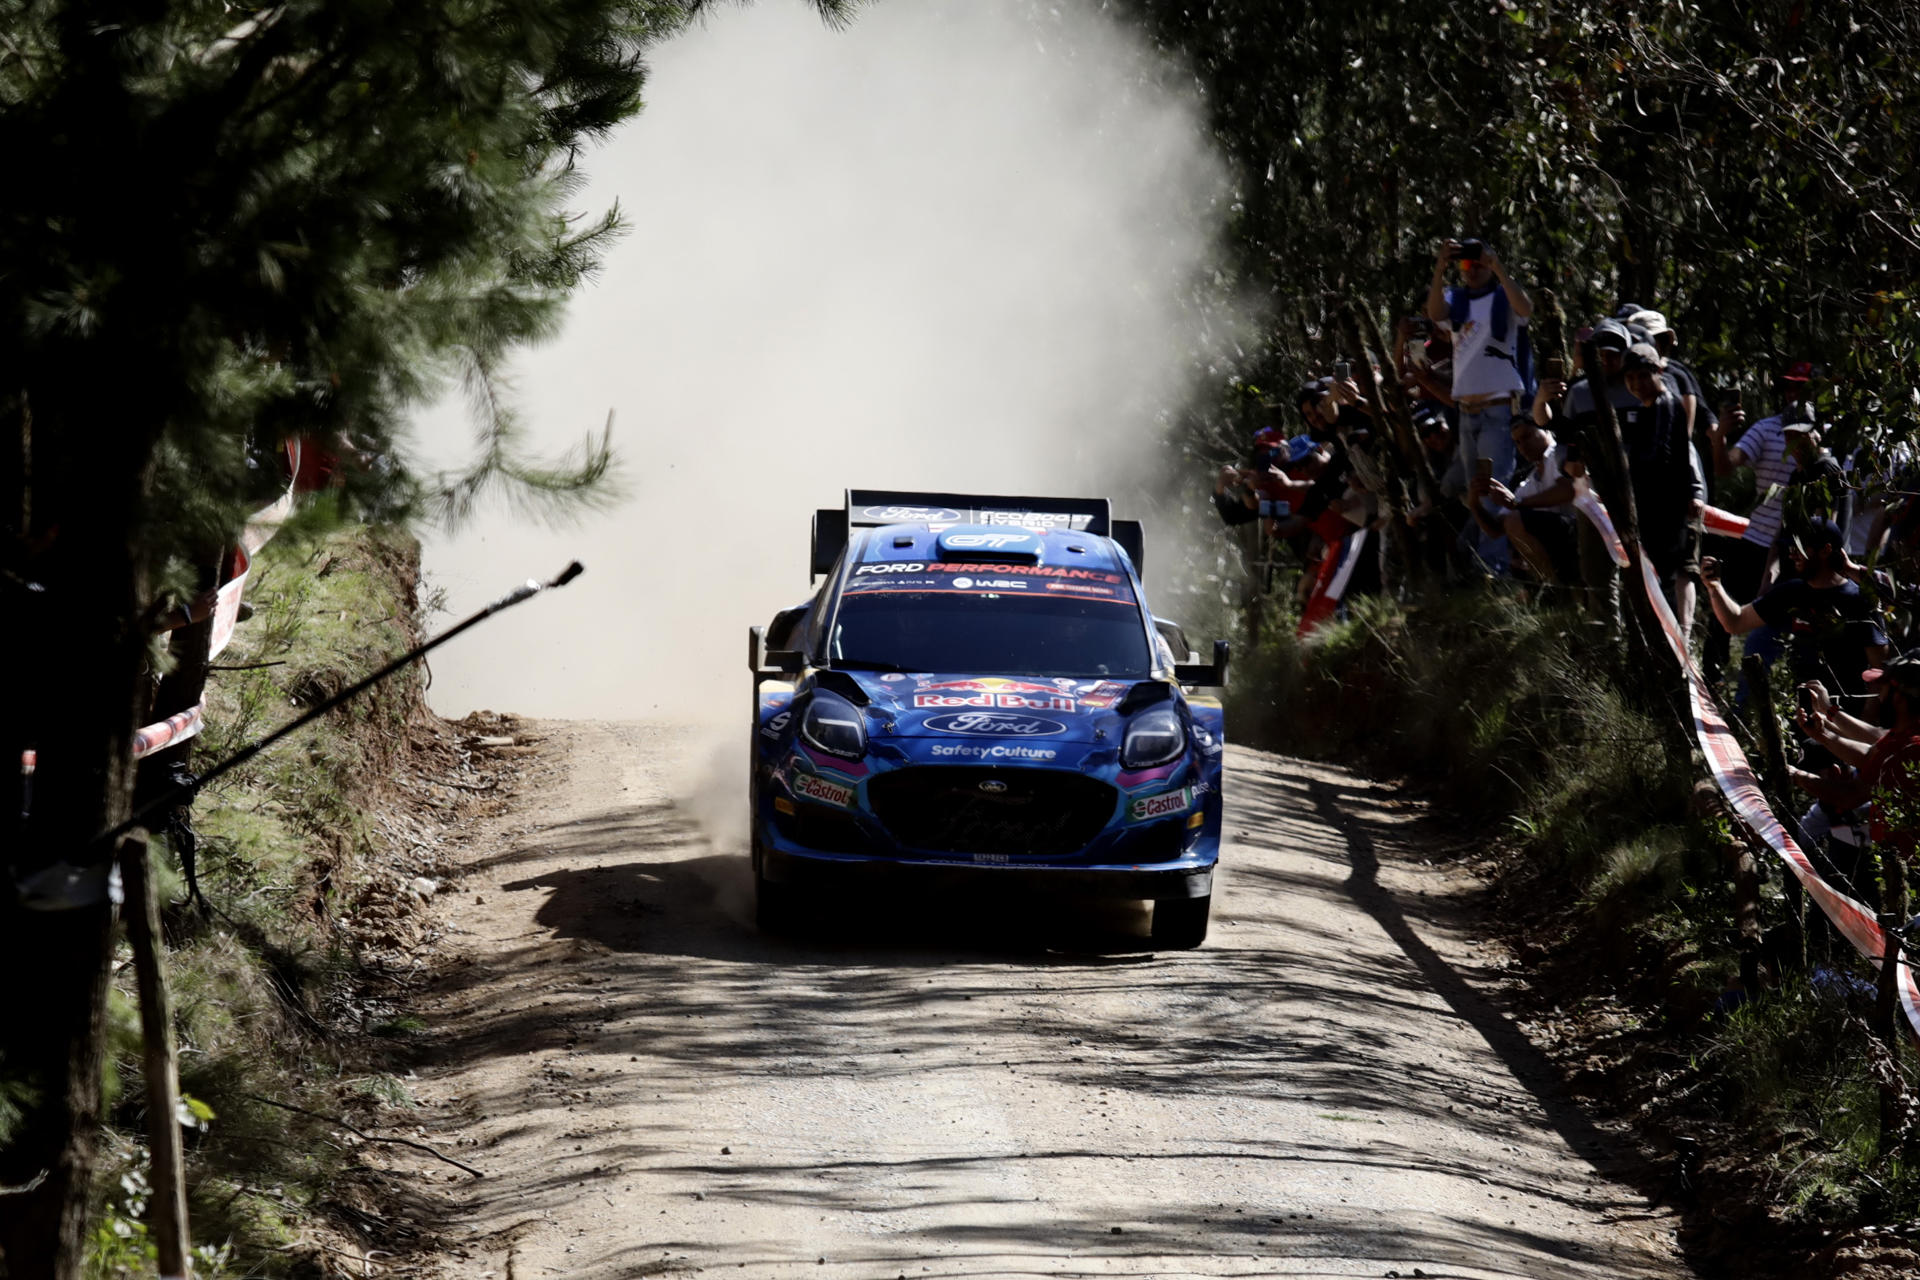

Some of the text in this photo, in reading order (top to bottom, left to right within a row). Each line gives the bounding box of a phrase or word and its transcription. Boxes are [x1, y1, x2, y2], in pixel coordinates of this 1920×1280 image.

[880, 506, 944, 520] Ford
[855, 563, 924, 575] FORD
[926, 563, 1121, 584] PERFORMANCE
[976, 579, 1027, 588] WRC
[914, 694, 1075, 712] Red Bull
[948, 712, 1041, 734] Ford
[931, 744, 1056, 760] SafetyCulture
[805, 779, 849, 805] Castrol
[1146, 792, 1186, 815] Castrol
